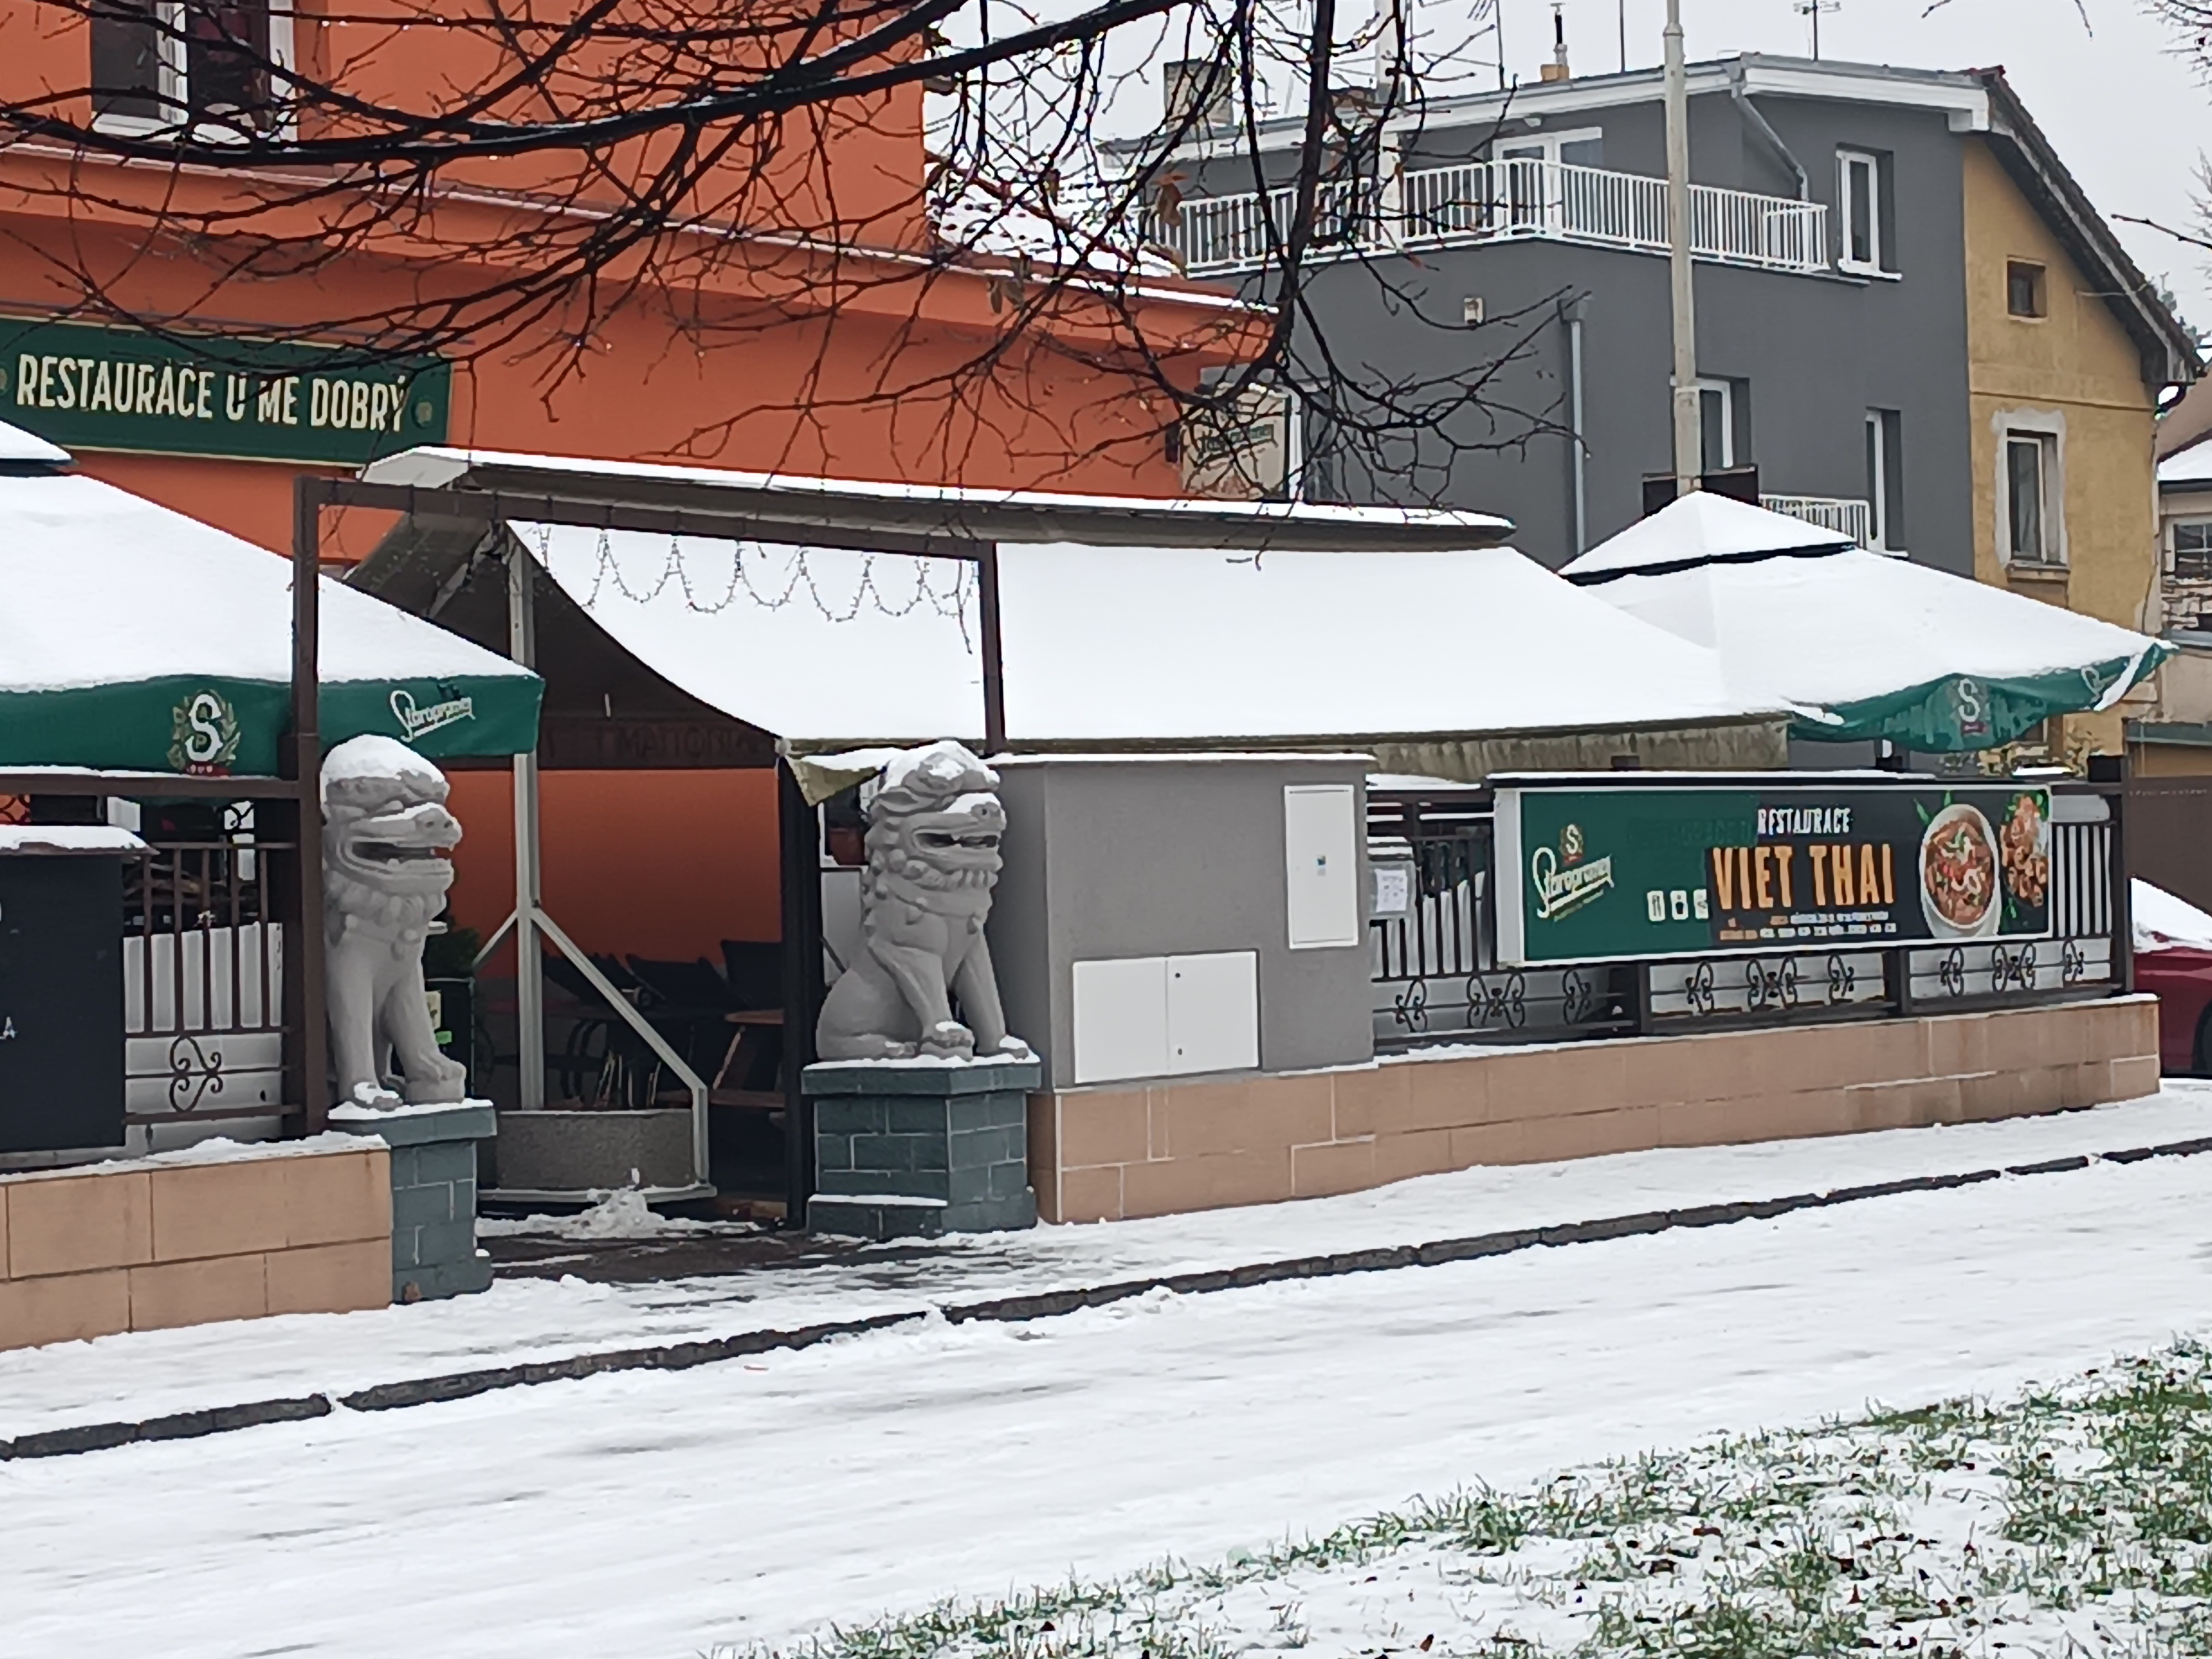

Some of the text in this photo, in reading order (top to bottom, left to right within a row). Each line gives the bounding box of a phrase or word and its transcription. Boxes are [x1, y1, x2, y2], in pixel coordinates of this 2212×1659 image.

[17, 353, 215, 418] RESTAURACE
[226, 372, 247, 420] U
[311, 375, 405, 431] DOBRÝ
[185, 694, 223, 761] S
[1757, 808, 1851, 835] RESTAURACE
[1713, 844, 1893, 909] VIET THAI
